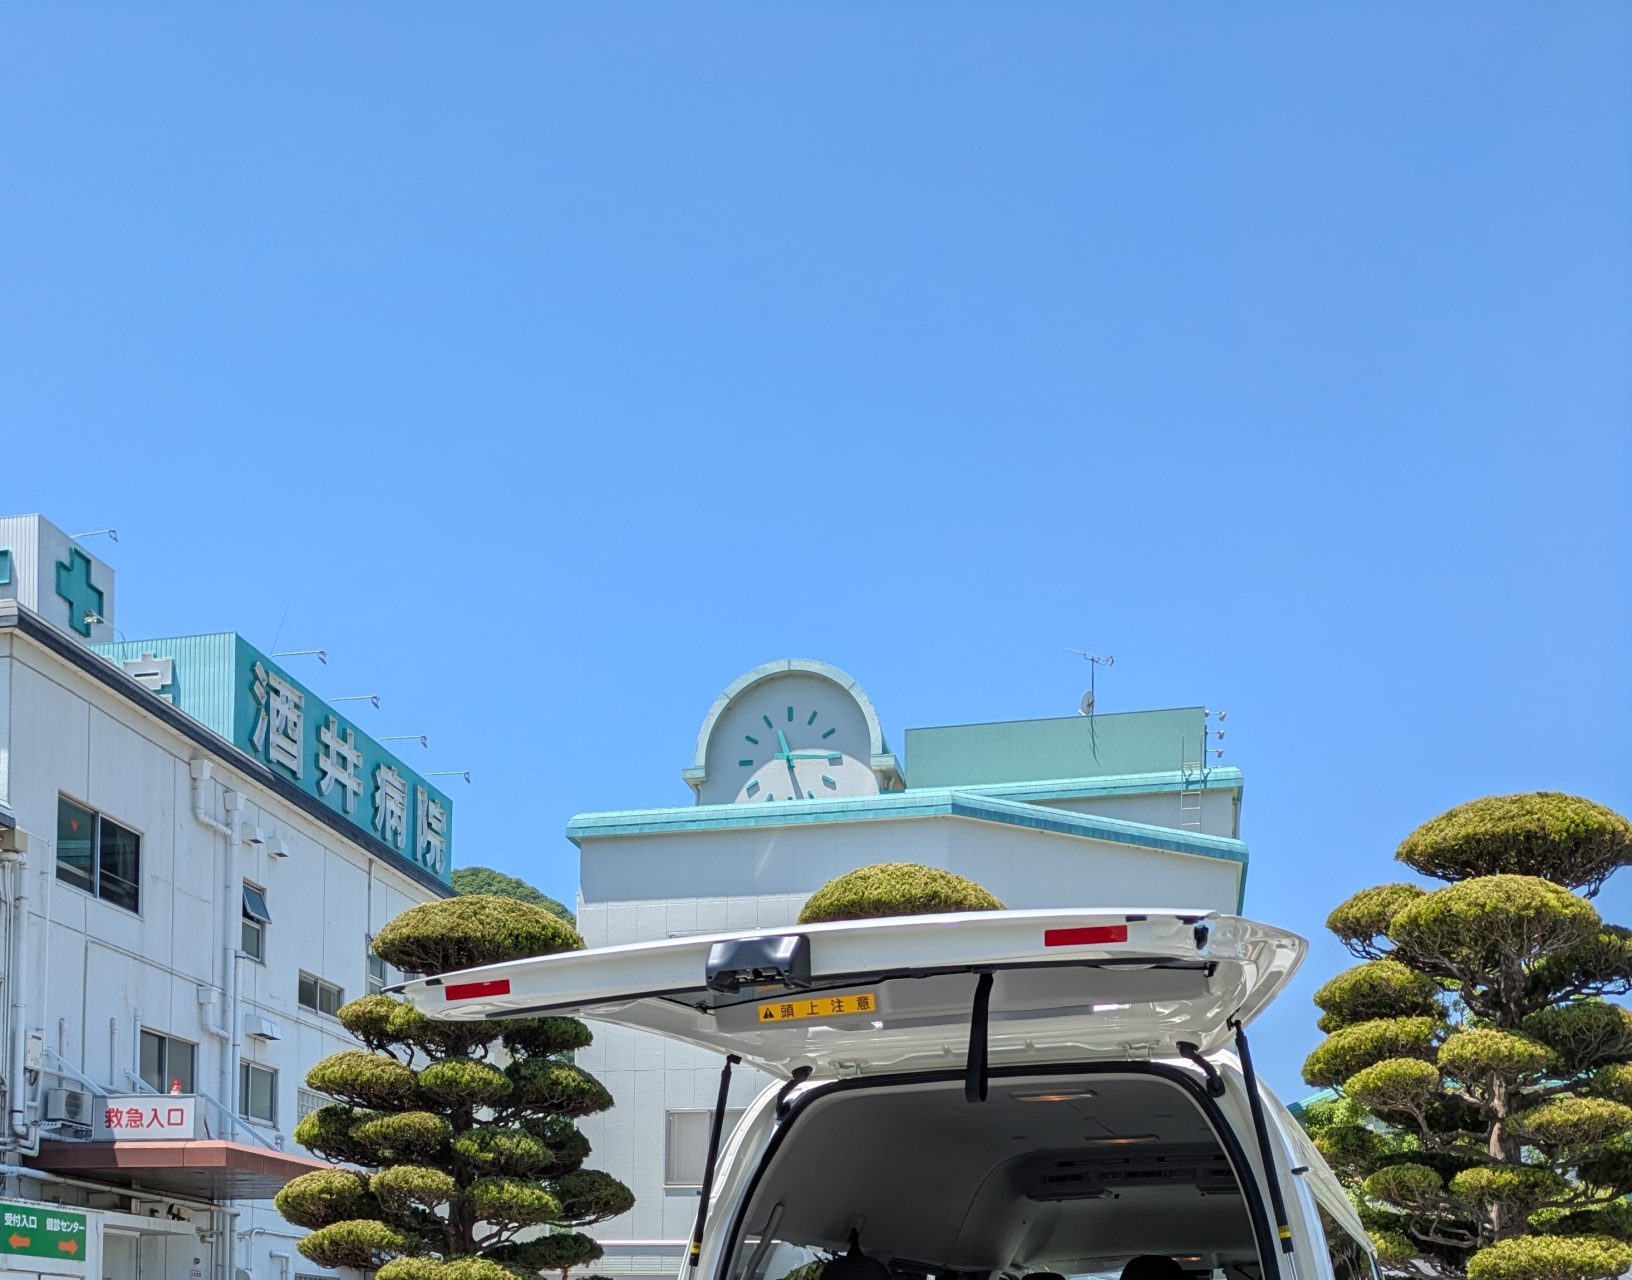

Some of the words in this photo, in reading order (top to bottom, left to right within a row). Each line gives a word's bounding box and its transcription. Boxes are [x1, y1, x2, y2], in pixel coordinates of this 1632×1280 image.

[251, 661, 447, 874] 酒井病院
[780, 996, 871, 1018] 頭上注意
[104, 1107, 184, 1129] 救急入口
[4, 1212, 37, 1229] 受付入口
[46, 1217, 85, 1233] 健診センター
